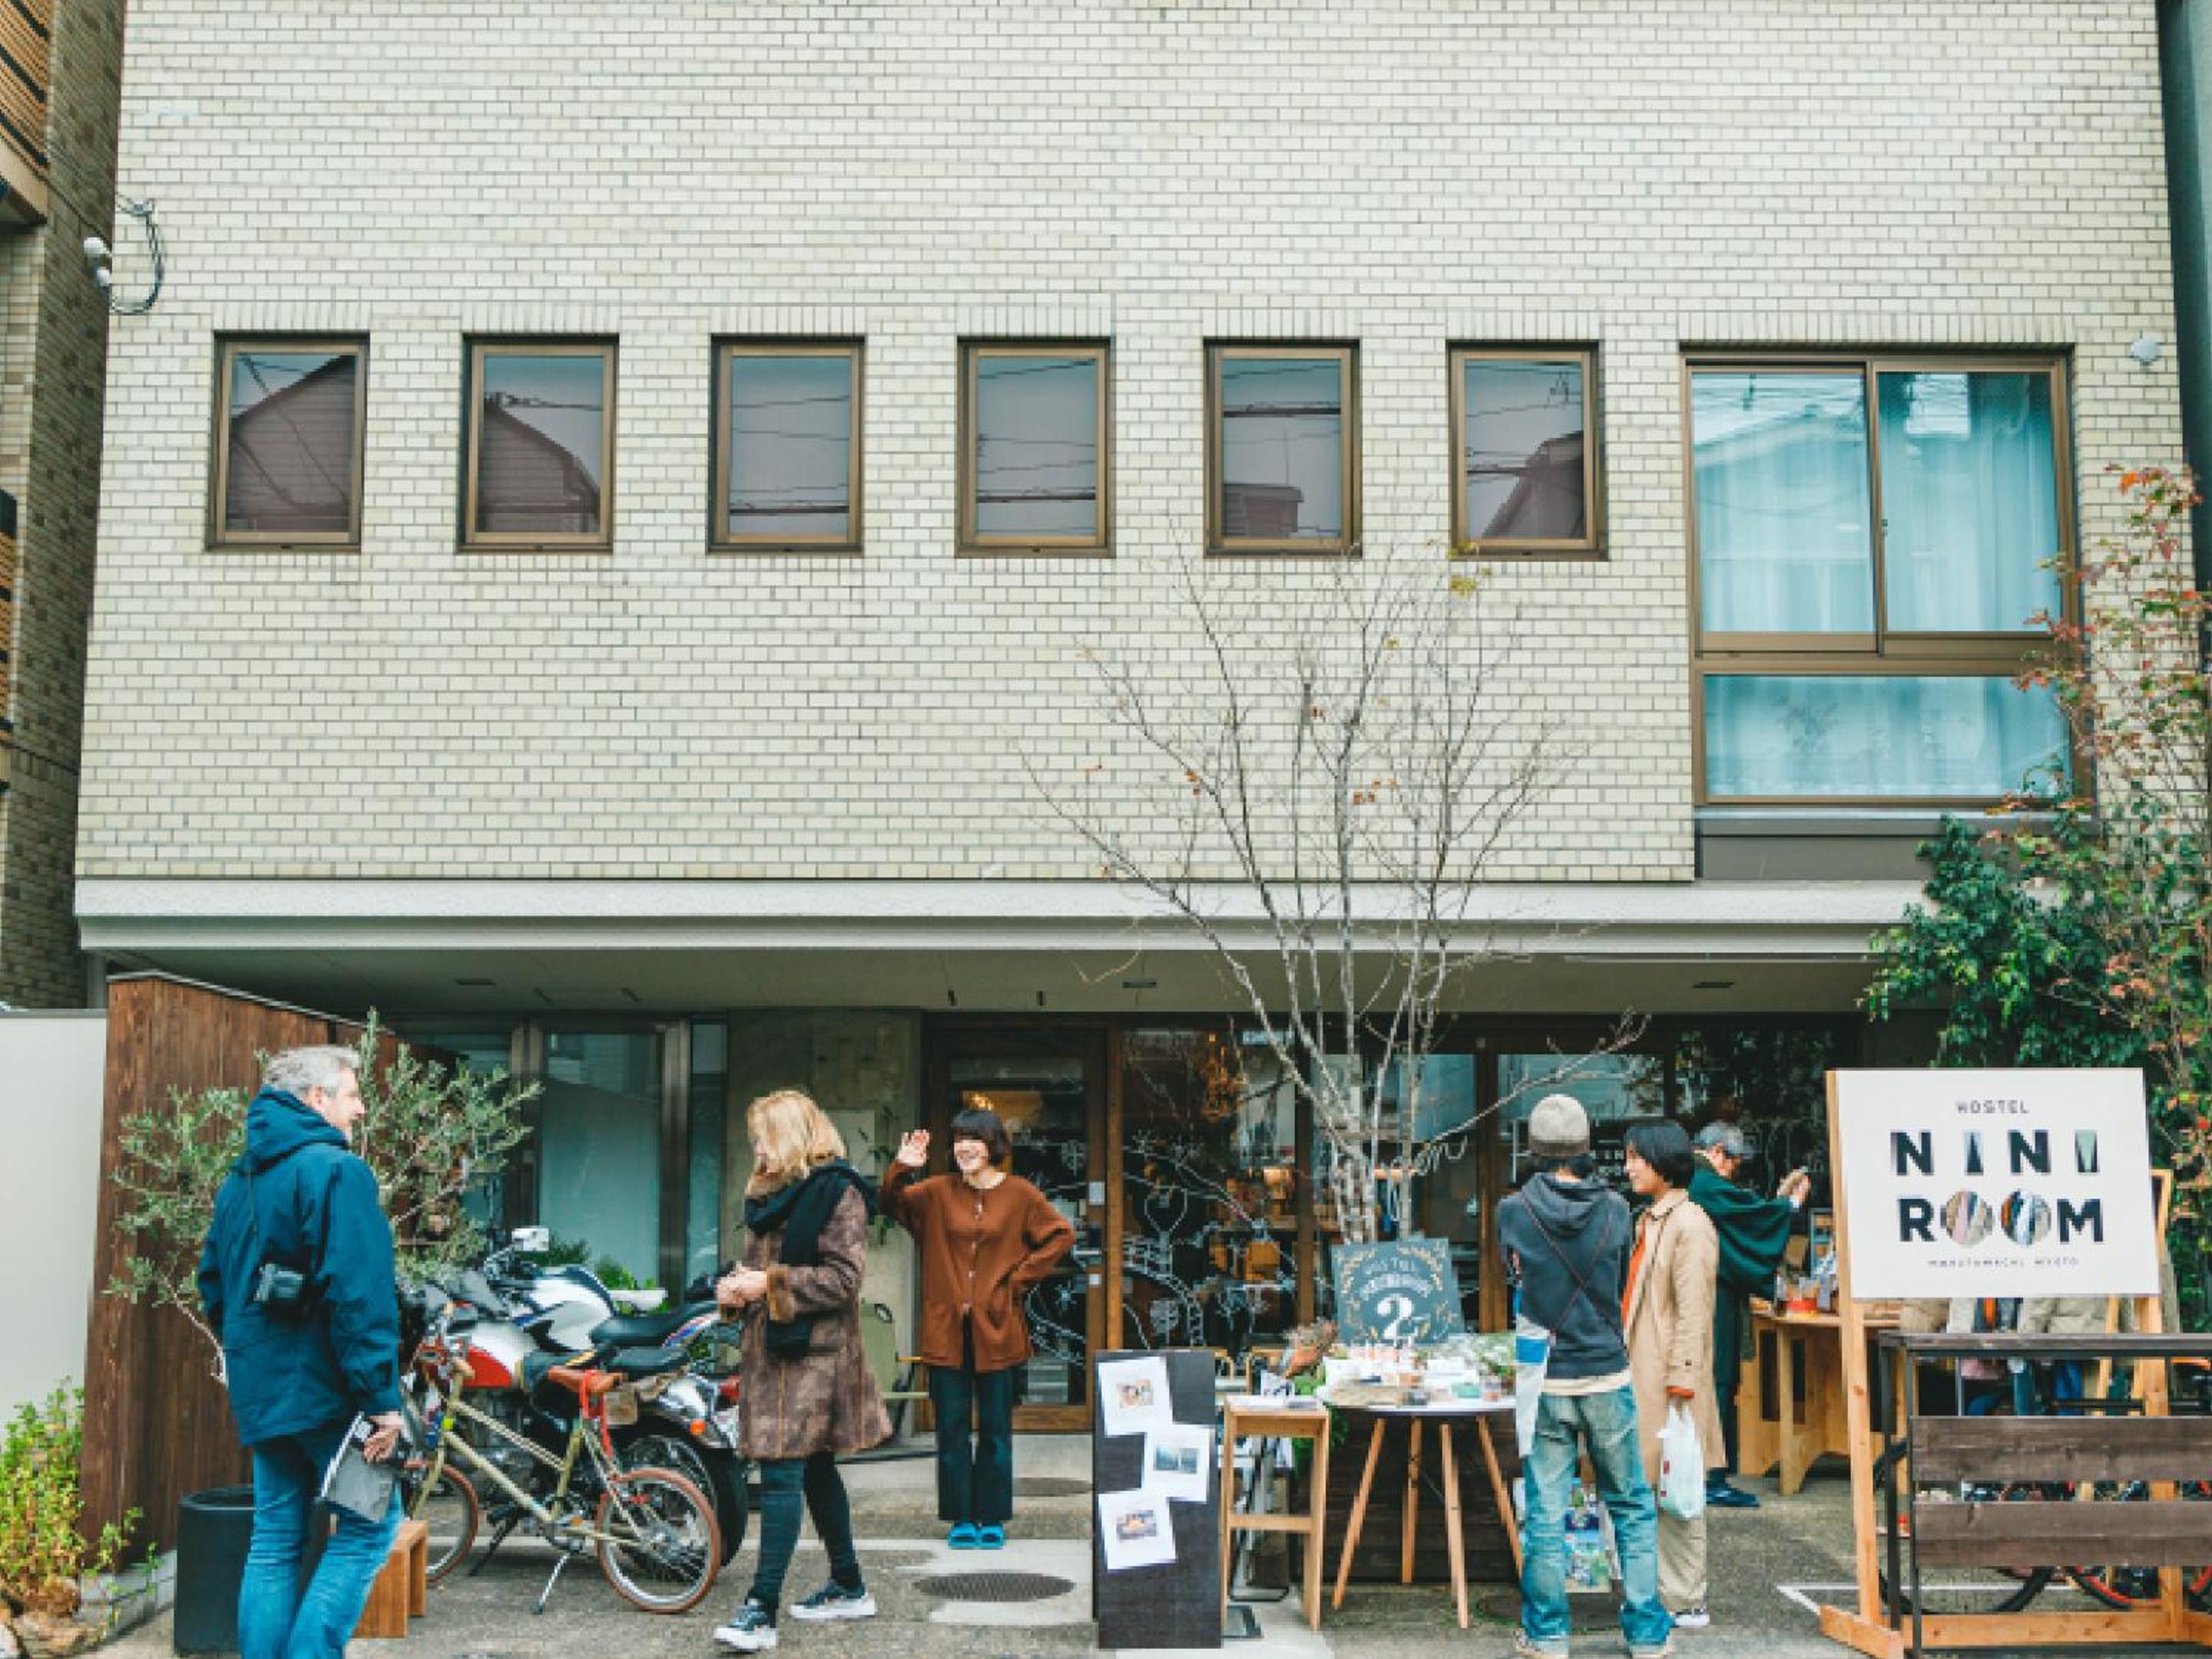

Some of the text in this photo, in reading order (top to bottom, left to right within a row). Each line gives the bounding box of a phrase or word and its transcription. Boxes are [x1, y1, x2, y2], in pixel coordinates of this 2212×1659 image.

[1956, 1098, 2029, 1114] HOSTEL
[1889, 1130, 2099, 1175] NINI
[1896, 1190, 2104, 1246] ROOM
